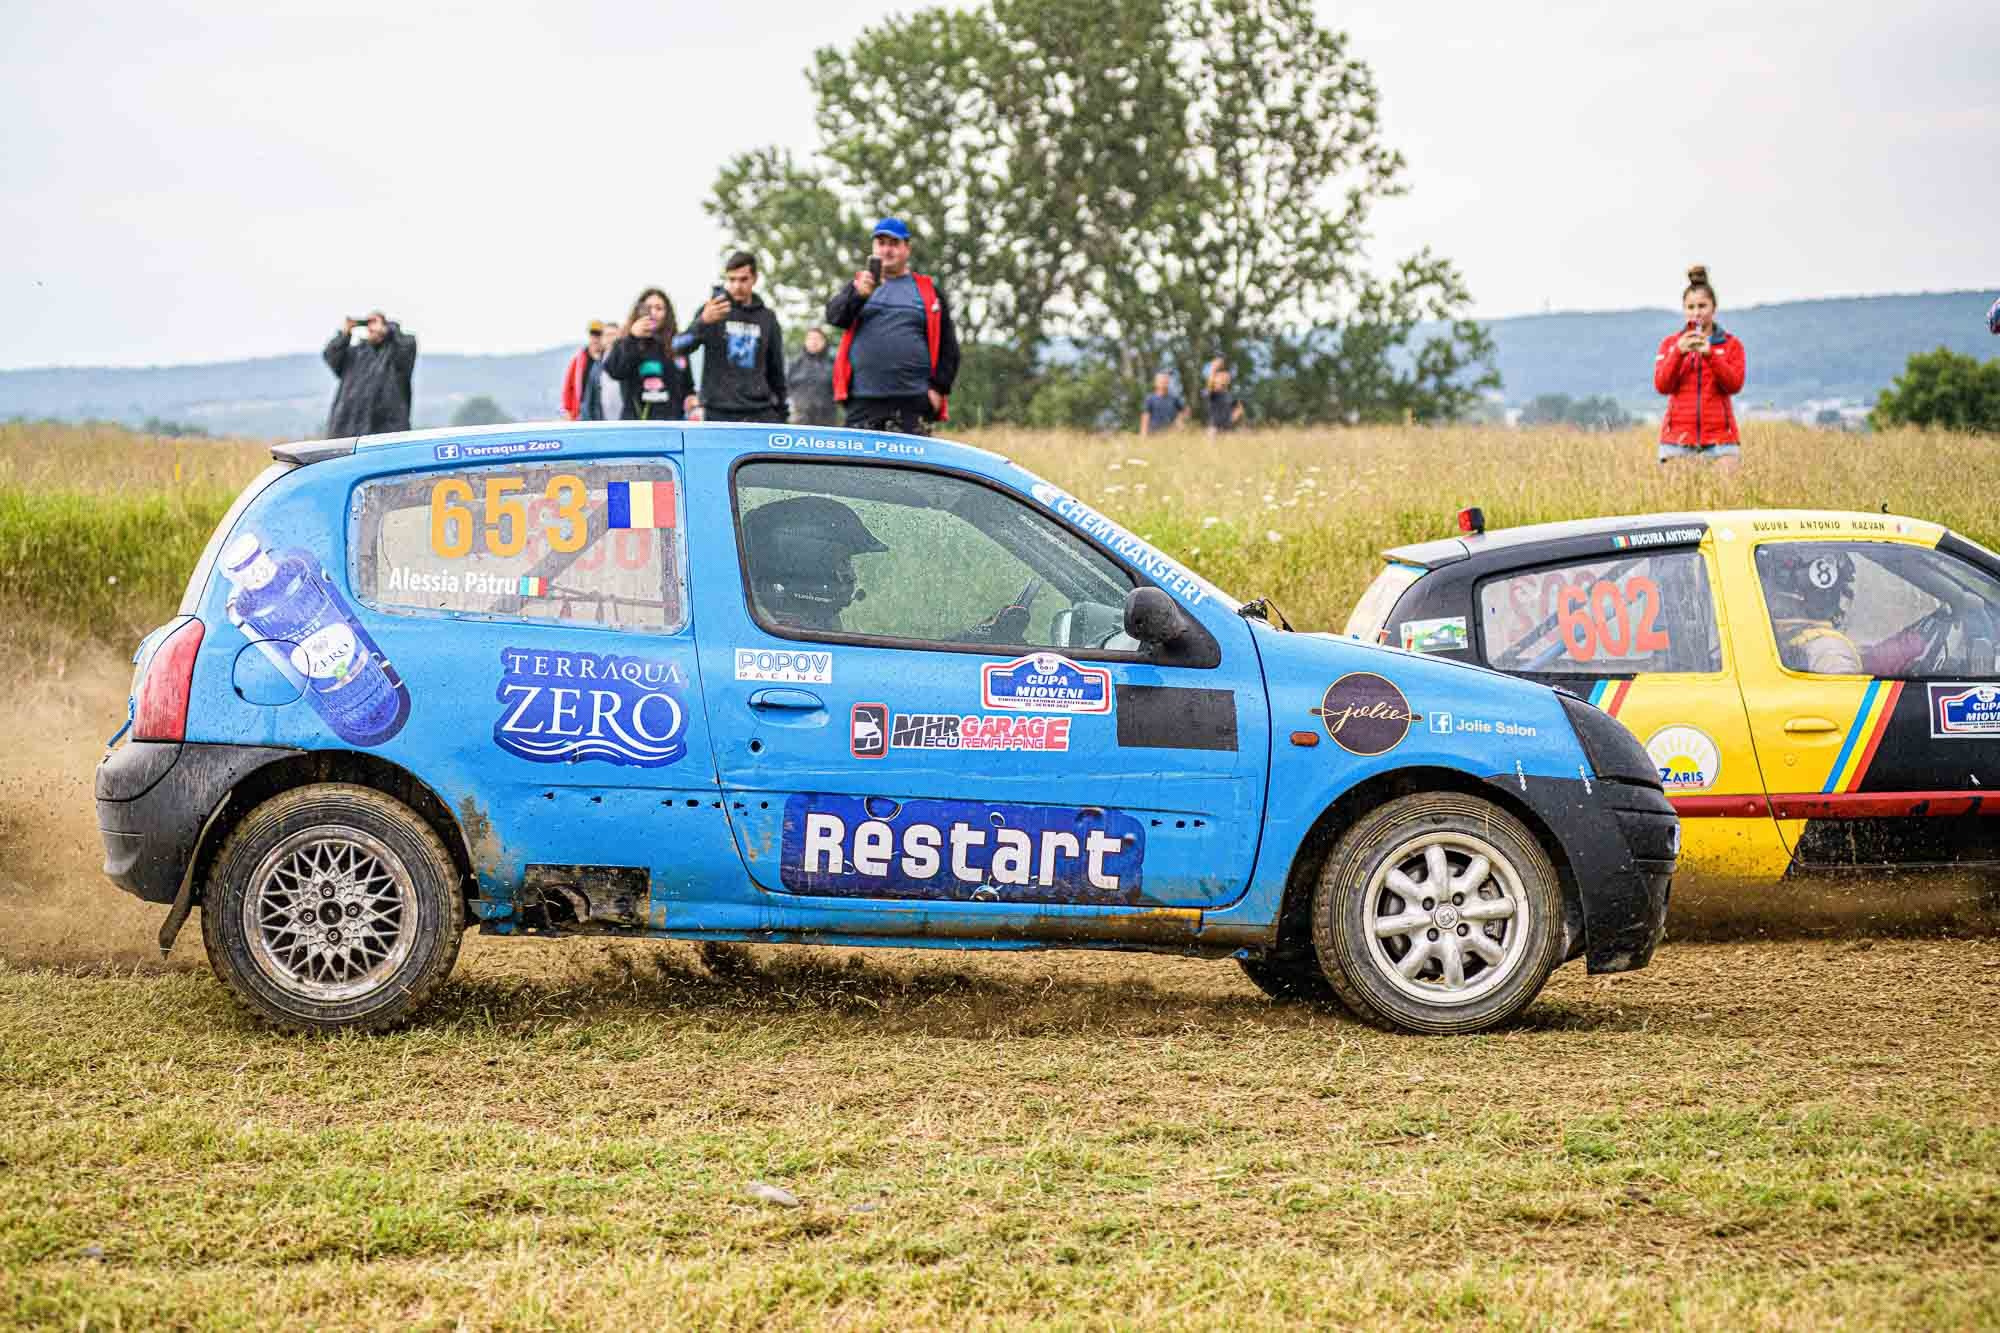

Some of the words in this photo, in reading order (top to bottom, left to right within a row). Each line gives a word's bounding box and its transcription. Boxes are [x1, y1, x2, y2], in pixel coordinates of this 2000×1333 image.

[464, 445, 526, 456] Terraqua
[528, 440, 561, 451] Zero
[431, 474, 589, 559] 653
[1800, 520, 1841, 529] ANTONIO
[1057, 500, 1209, 606] CHEMTRANSFERT
[389, 567, 459, 593] Alessia
[1557, 575, 1671, 664] 602
[507, 653, 682, 691] TERRAQUA
[739, 651, 829, 674] POPOV
[739, 672, 823, 682] RACING
[1026, 675, 1068, 686] CUPA
[1015, 686, 1085, 700] MIOVENI
[502, 683, 682, 753] ZERO
[1331, 701, 1401, 734] jolie
[1456, 720, 1492, 734] Jolie
[1495, 721, 1537, 737] Salon
[924, 737, 960, 748] ECU
[961, 737, 1044, 749] REMAPPING
[1658, 768, 1704, 783] ZARIS
[803, 812, 1122, 890] Restart
